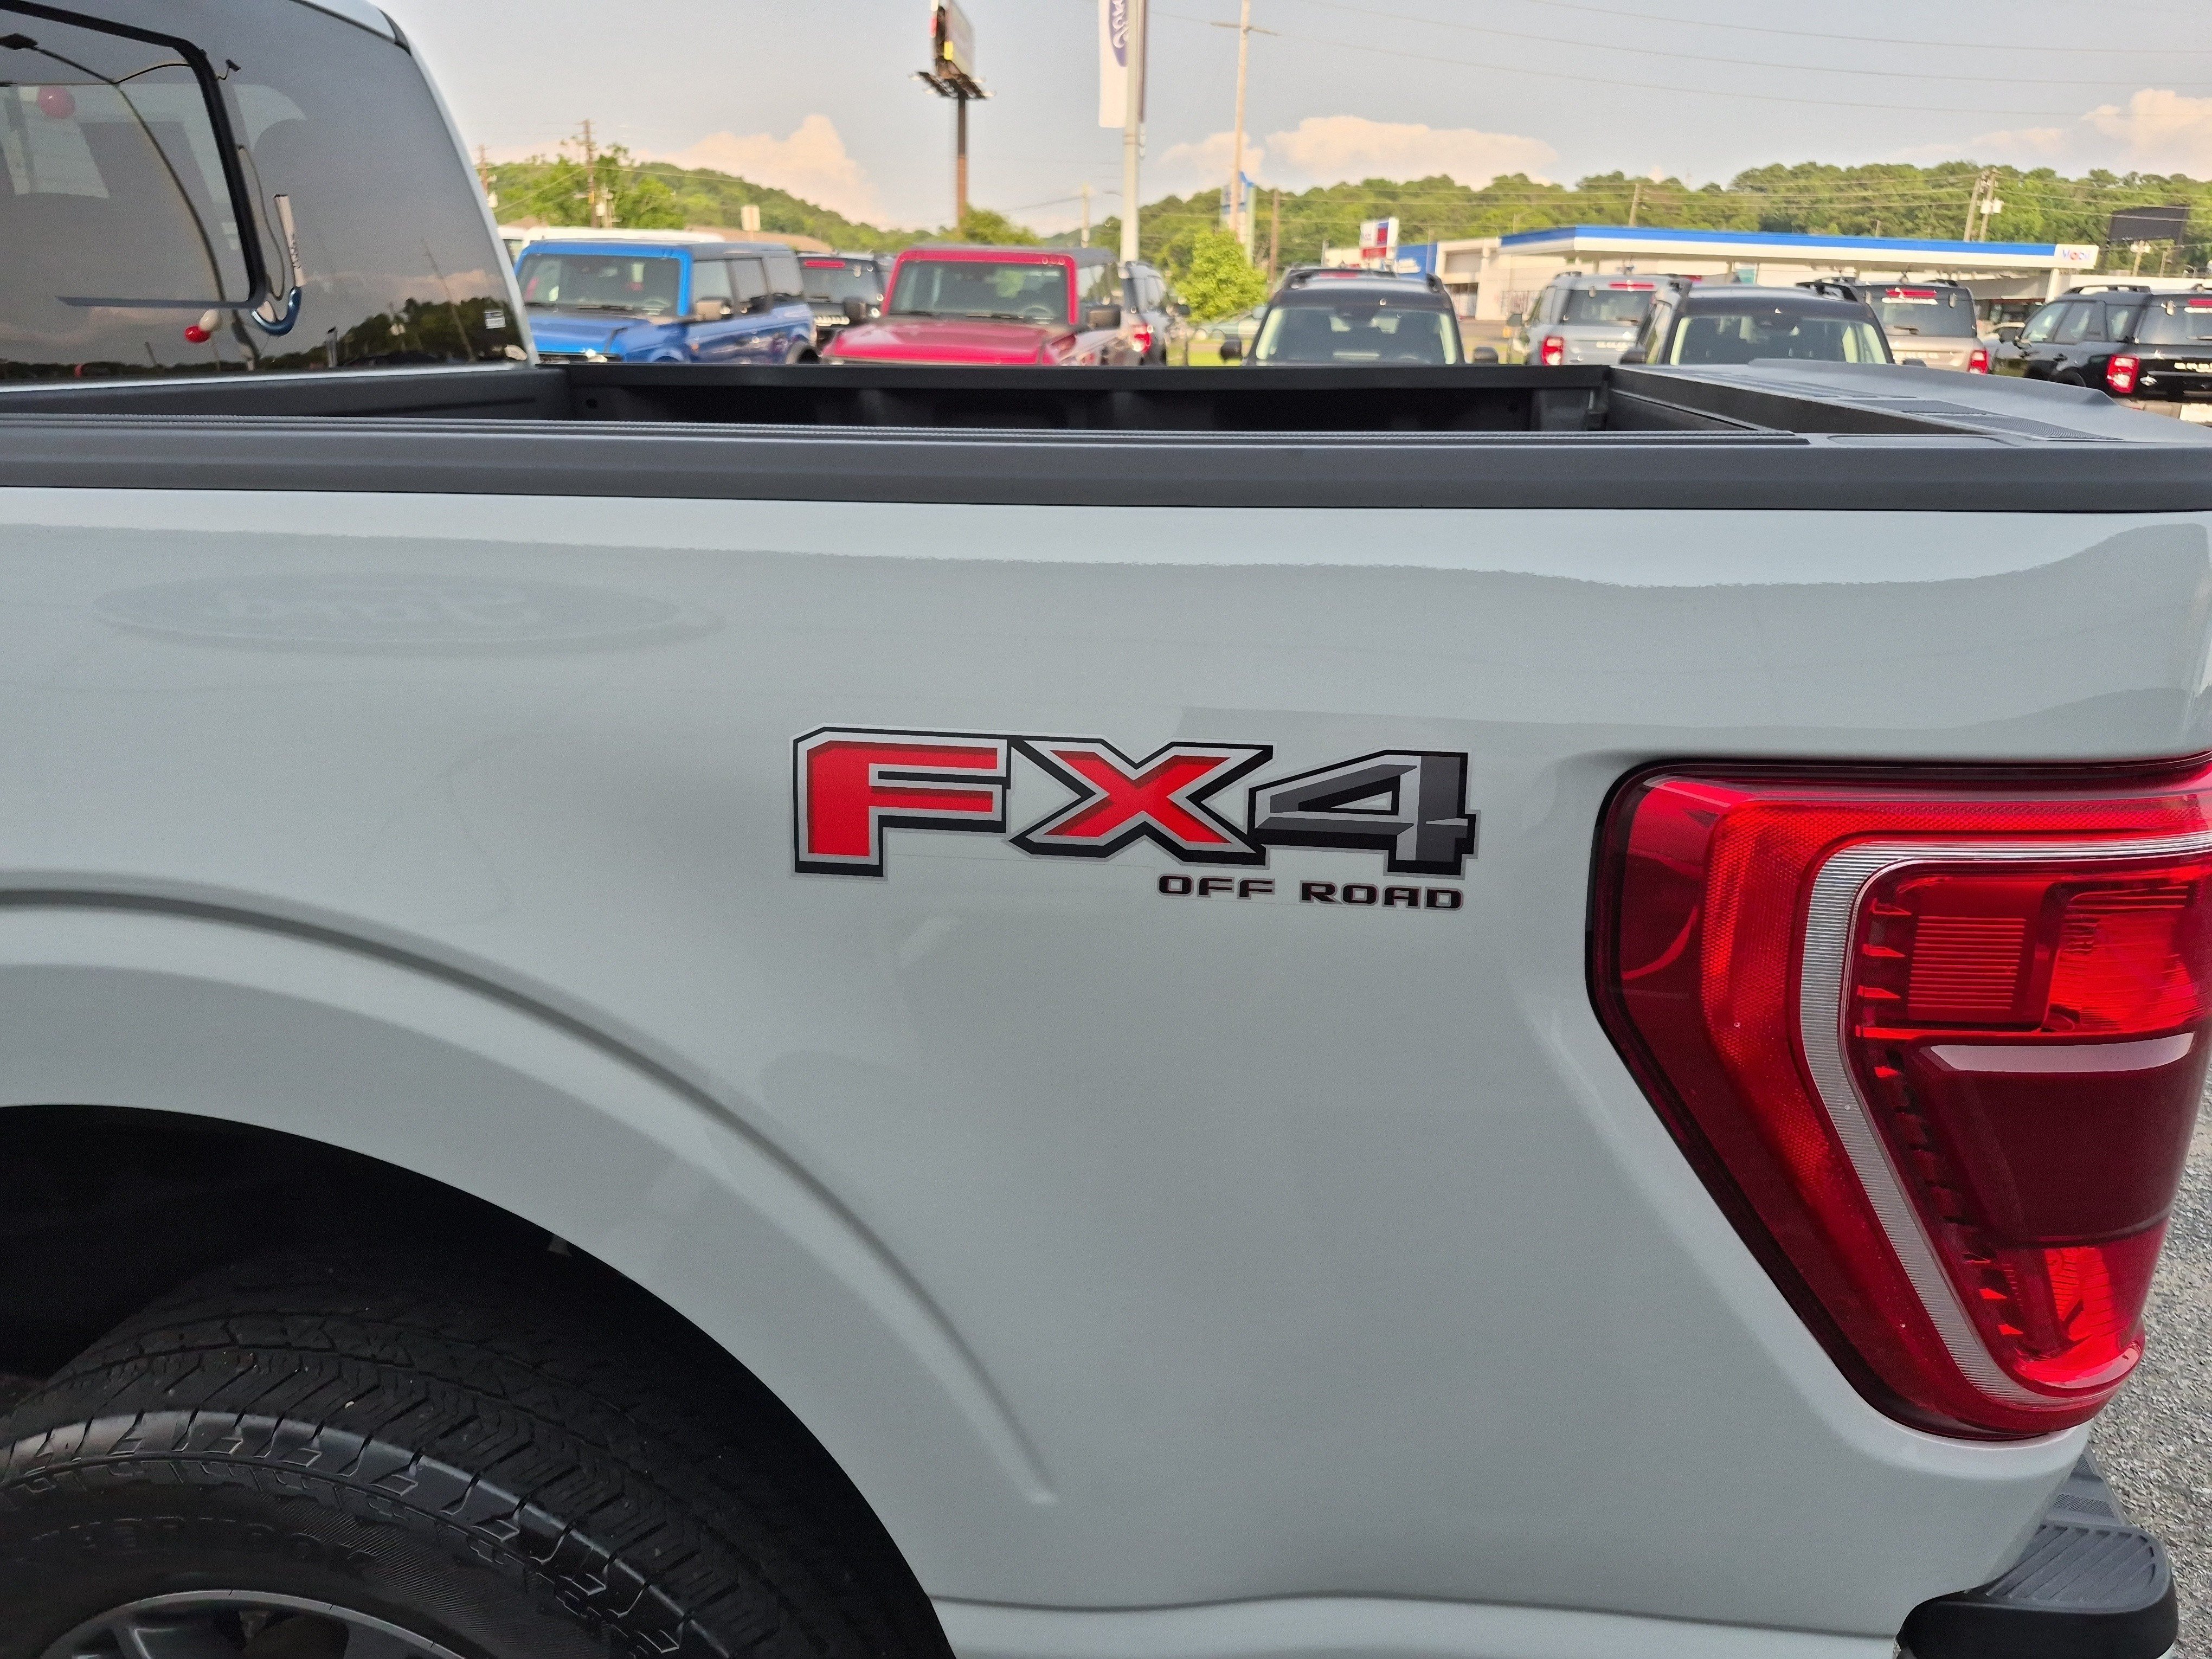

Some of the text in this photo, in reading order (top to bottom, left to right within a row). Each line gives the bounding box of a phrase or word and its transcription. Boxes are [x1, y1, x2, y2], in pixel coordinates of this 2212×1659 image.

[789, 722, 1481, 879] FX4
[1158, 873, 1464, 911] OFF ROAD
